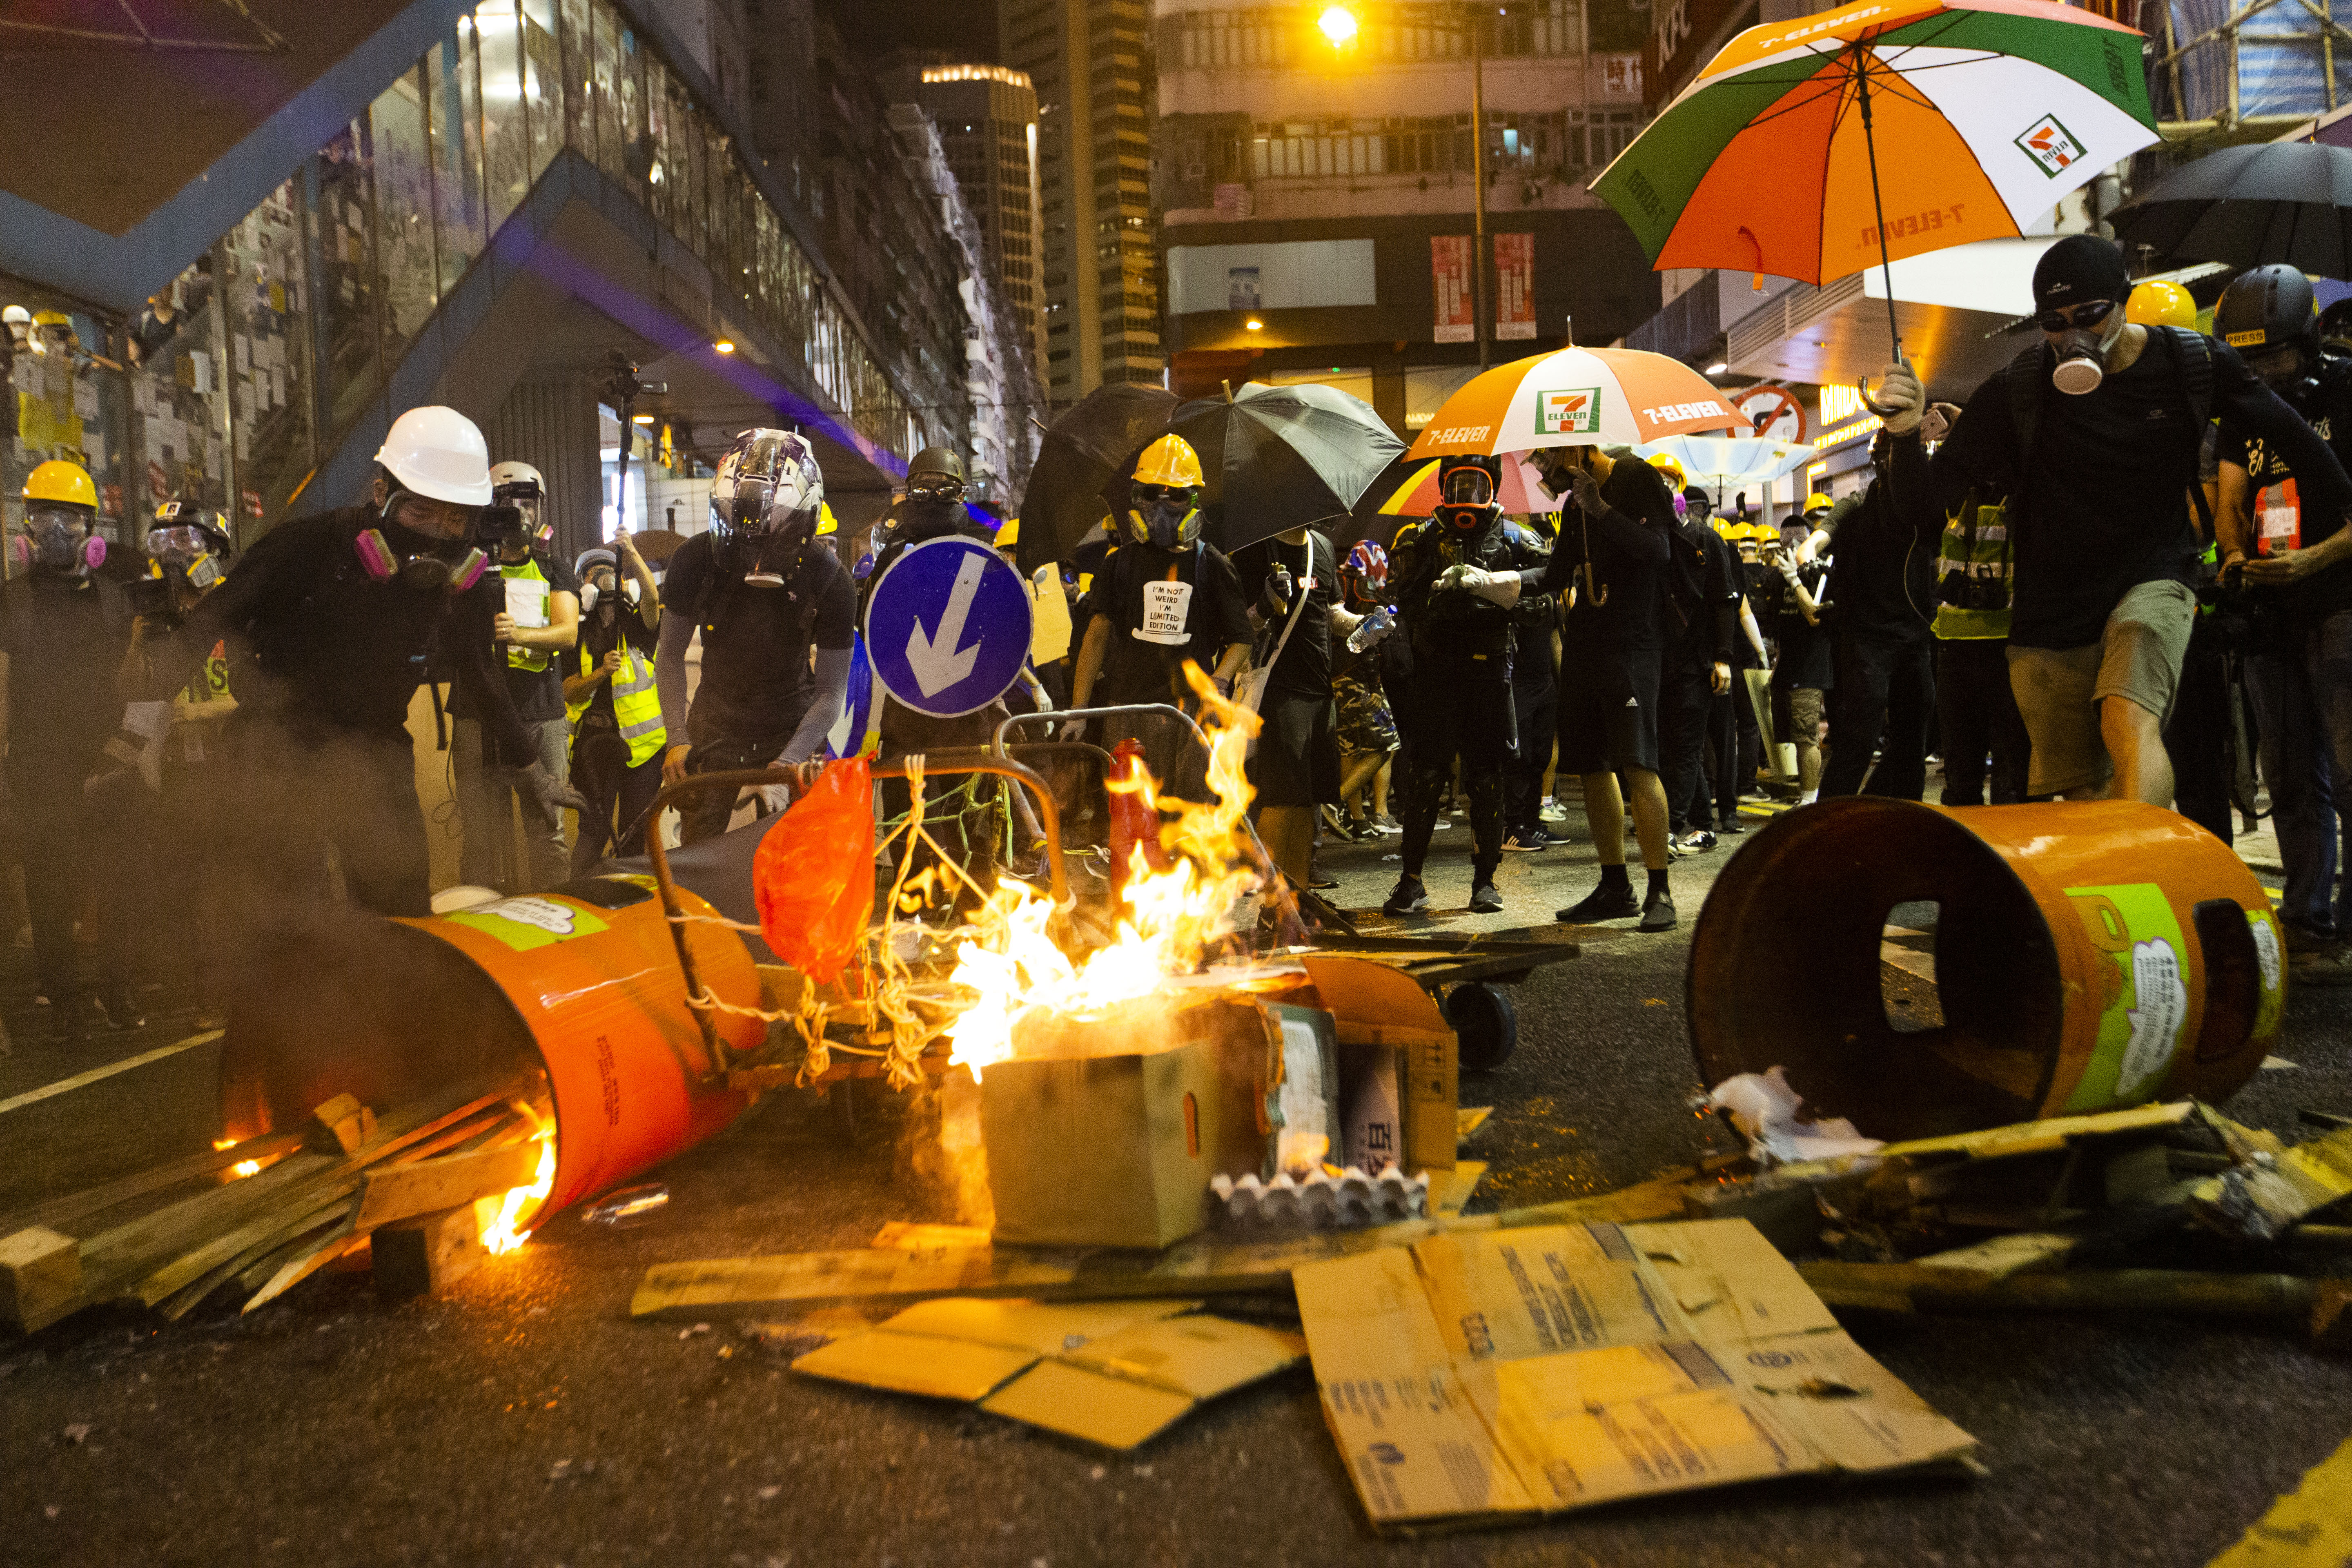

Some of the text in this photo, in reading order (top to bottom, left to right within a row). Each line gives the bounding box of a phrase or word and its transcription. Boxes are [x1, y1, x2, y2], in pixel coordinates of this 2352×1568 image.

[2227, 332, 2263, 343] PRESS
[1155, 595, 1178, 604] WEIRD
[1150, 612, 1180, 621] LIMITED
[1149, 622, 1178, 630] EDITION
